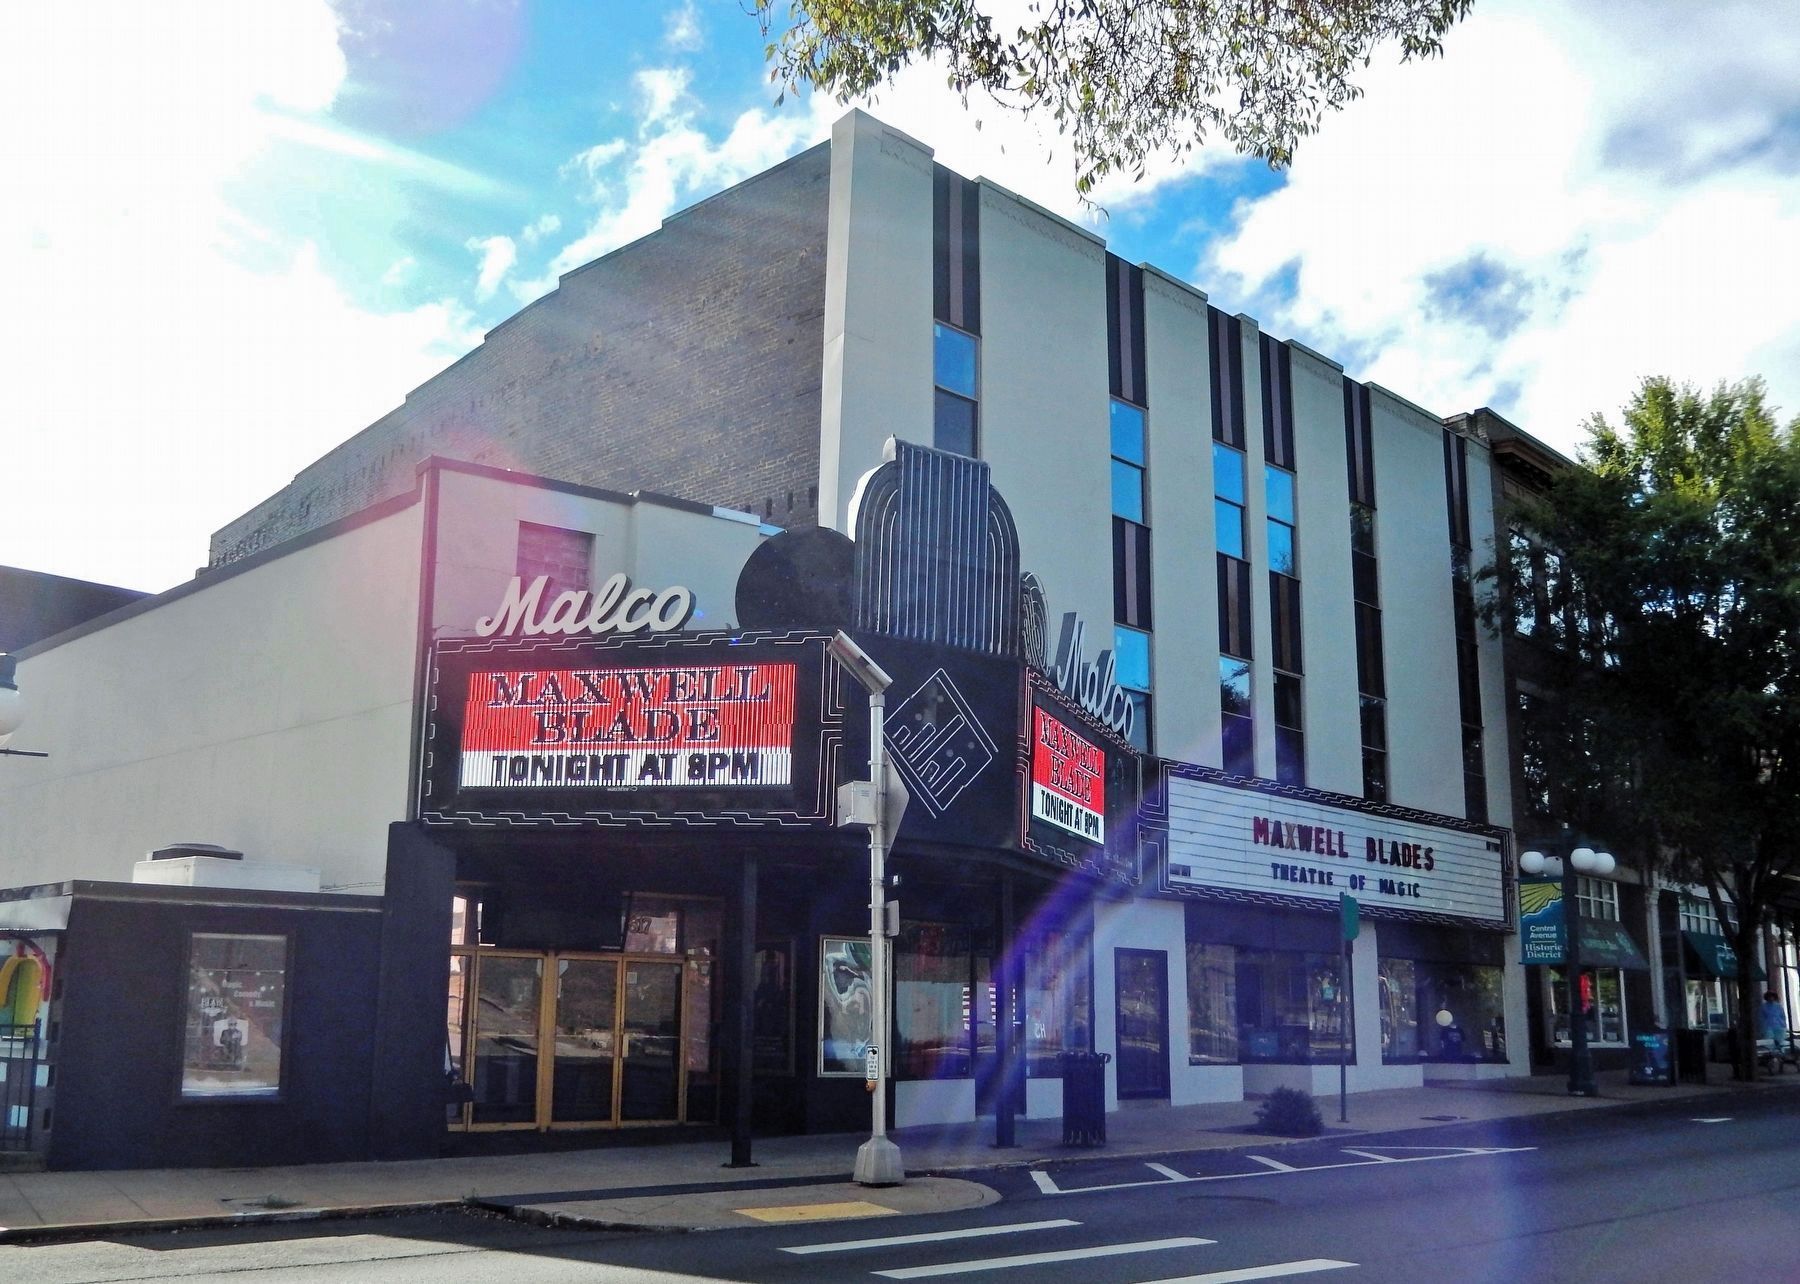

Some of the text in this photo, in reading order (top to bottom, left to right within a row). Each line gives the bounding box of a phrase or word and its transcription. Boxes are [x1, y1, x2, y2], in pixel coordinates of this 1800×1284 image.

[476, 573, 693, 637] Malco
[487, 666, 772, 708] MAXWELL
[1056, 612, 1134, 742] Malco
[530, 707, 722, 744] BLADE
[1040, 712, 1101, 777] MAXWELL
[493, 751, 760, 783] TONIGHT AT 8PM
[1051, 754, 1093, 804] BLADE
[1041, 790, 1100, 839] TONIGHT AT 8PM
[1253, 816, 1434, 871] MAXWELL BLADES
[1271, 862, 1420, 898] THEATRE OF MAGIC
[1525, 943, 1563, 951] Historic
[1527, 951, 1561, 959] District
